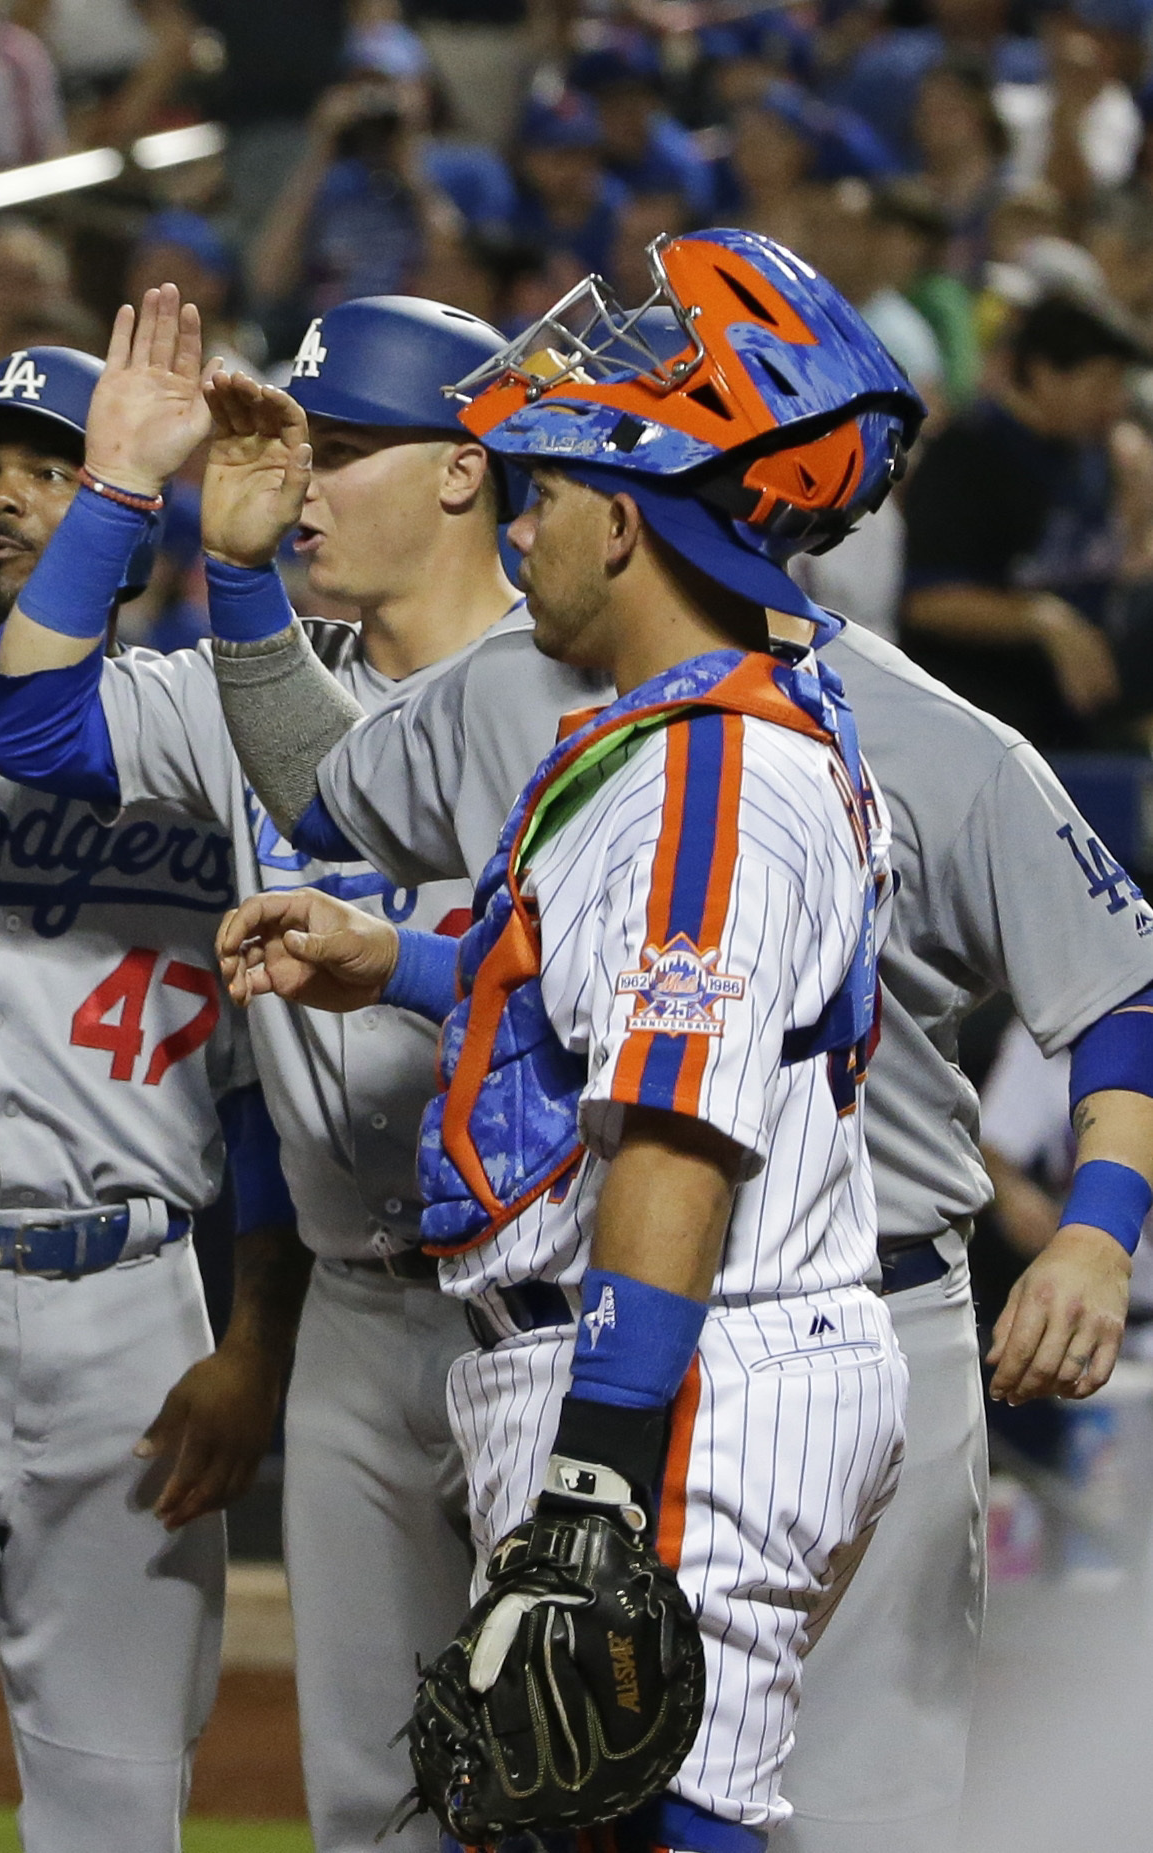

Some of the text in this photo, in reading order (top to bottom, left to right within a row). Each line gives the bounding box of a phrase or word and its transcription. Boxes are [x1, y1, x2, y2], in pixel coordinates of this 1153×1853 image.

[292, 318, 327, 377] LA
[1056, 822, 1143, 915] LA
[620, 975, 648, 988] 1962
[709, 979, 740, 994] 1986
[69, 946, 221, 1086] 47
[631, 1020, 718, 1032] ANNIVERSARY
